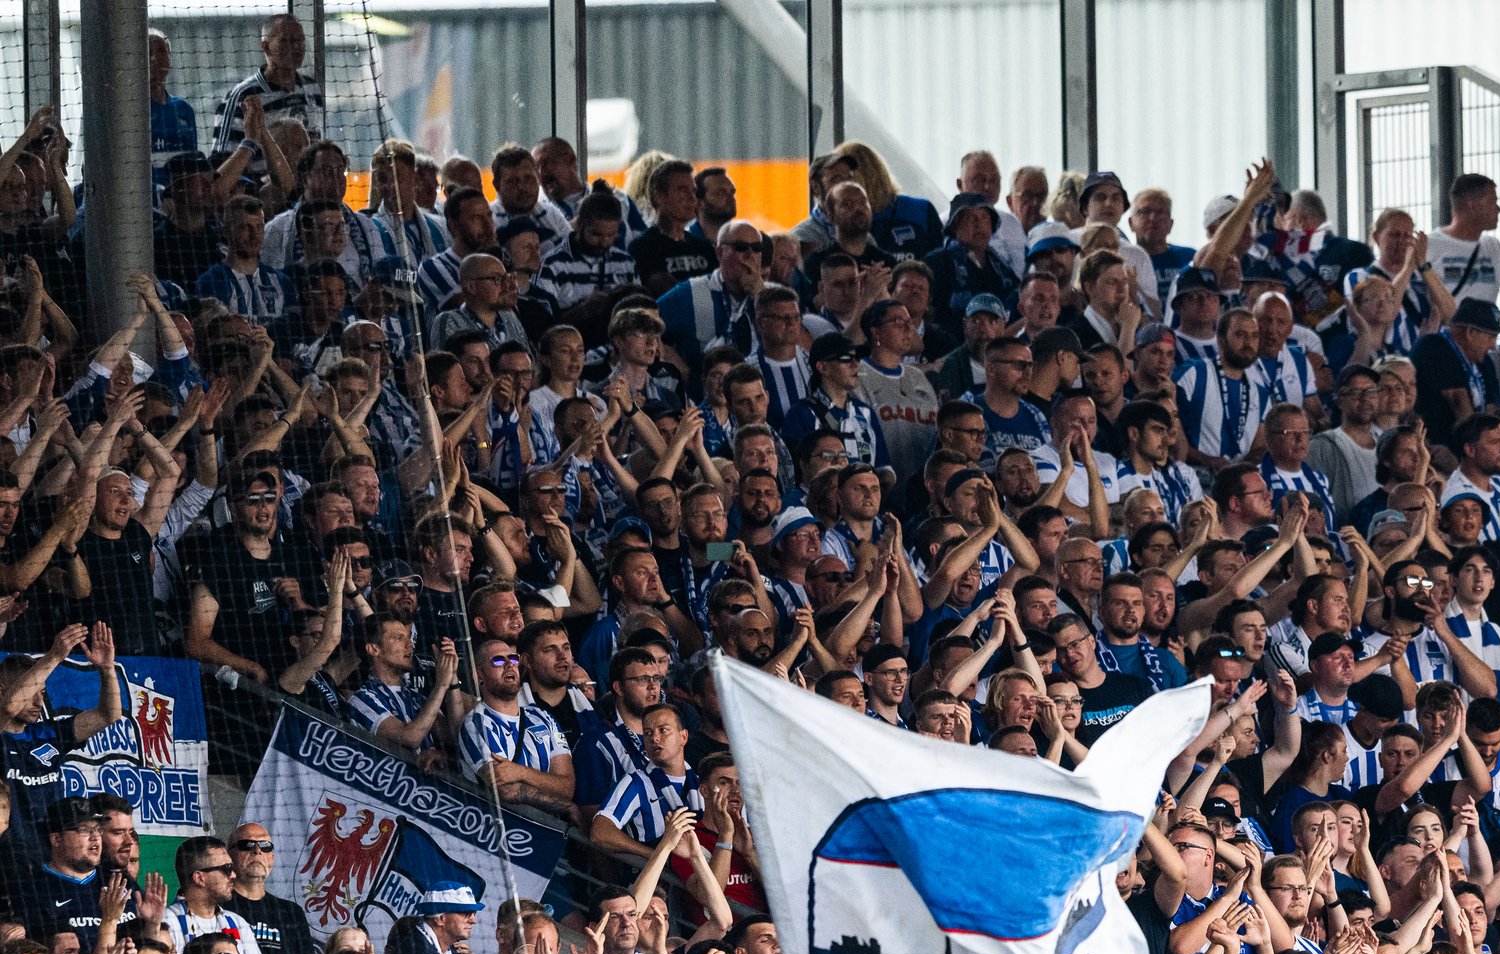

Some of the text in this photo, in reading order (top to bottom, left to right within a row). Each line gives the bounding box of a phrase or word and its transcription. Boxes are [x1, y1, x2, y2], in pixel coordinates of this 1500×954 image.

[666, 255, 709, 273] ZERO
[298, 721, 534, 859] Herthazone
[69, 911, 137, 929] AUTOERO
